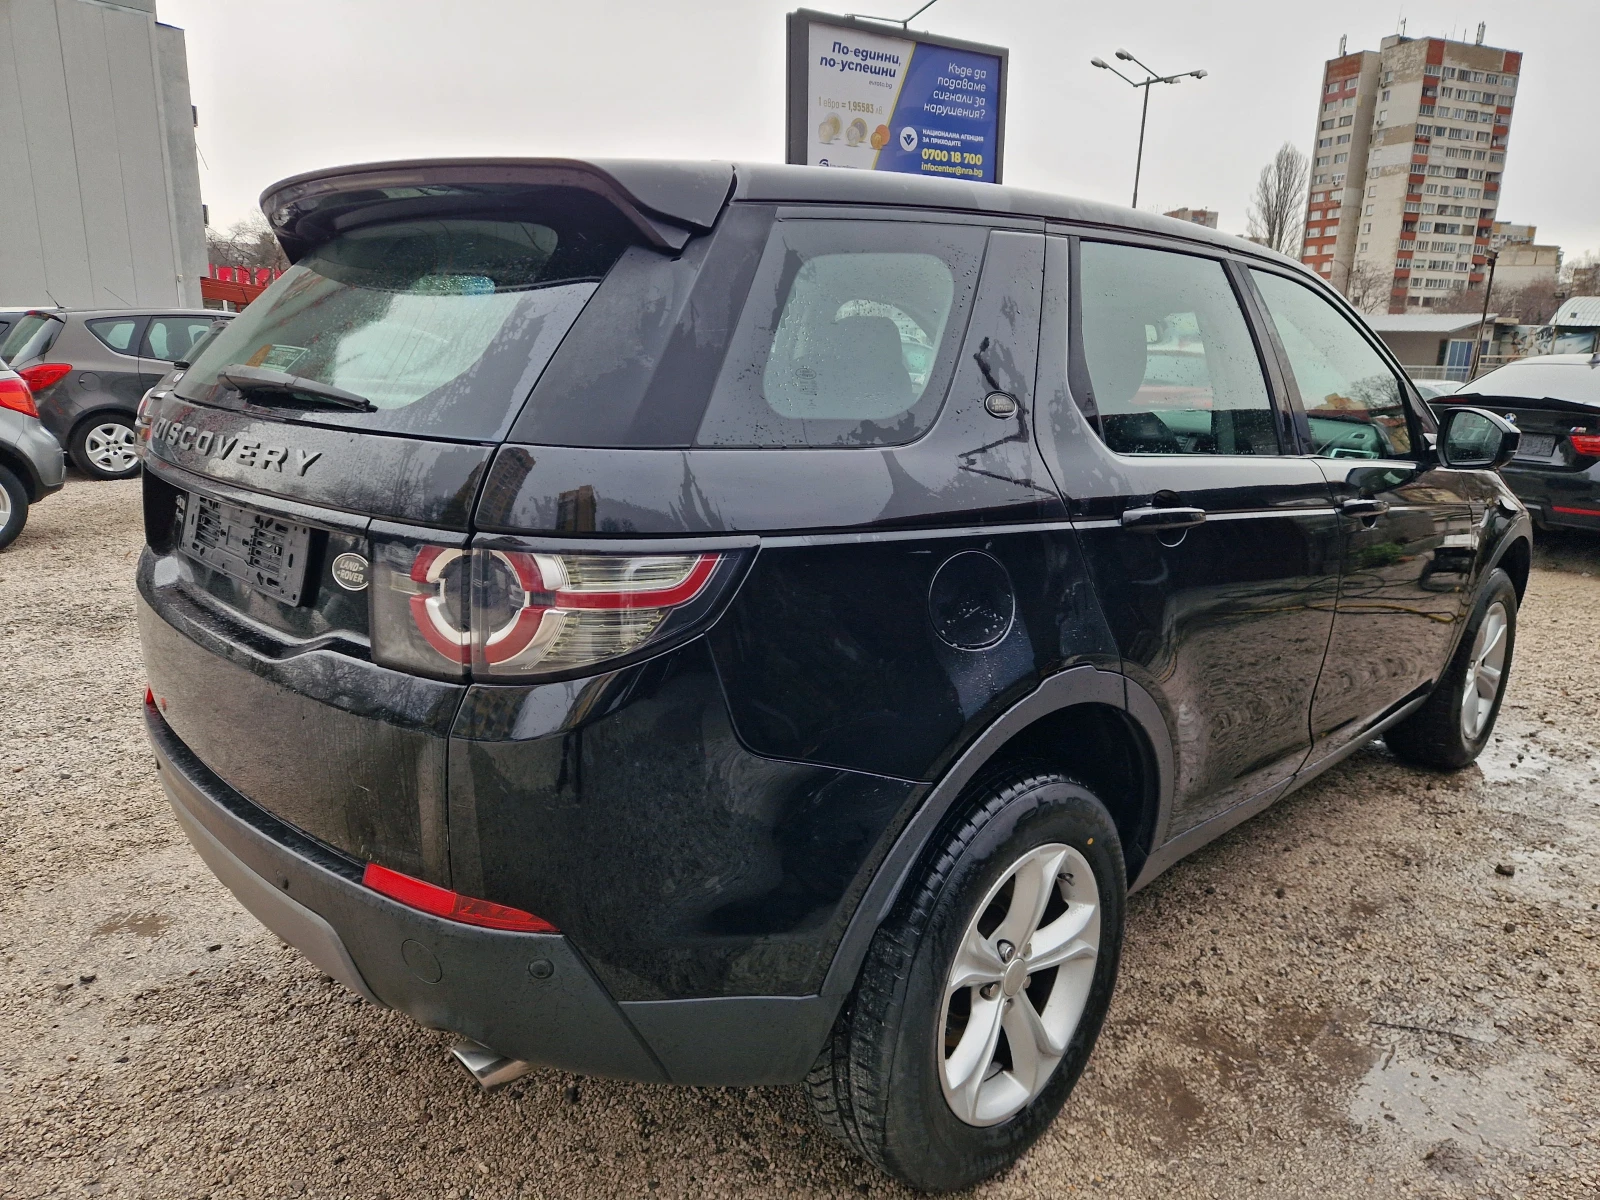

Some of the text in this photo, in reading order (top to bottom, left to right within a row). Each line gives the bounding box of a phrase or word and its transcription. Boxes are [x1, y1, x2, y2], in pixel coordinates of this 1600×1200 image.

[832, 41, 901, 67] По-единни,
[820, 56, 896, 78] по-успешни
[948, 62, 987, 80] Къде да
[937, 76, 986, 92] подаваме
[823, 98, 840, 109] евро
[847, 101, 874, 114] 1,95583
[933, 90, 985, 107] сигнали за
[923, 103, 986, 119] нарушения?
[922, 129, 984, 142] НАЦИОНАЛНА АГЕНЦИЯ
[930, 139, 961, 147] ПРИХОДИТЕ
[921, 148, 983, 165] 0700 18 700
[921, 162, 983, 177] infocenter@nra.bg
[153, 417, 322, 477] DISCOVERY
[340, 560, 360, 571] LAND
[340, 570, 364, 584] ROVER
